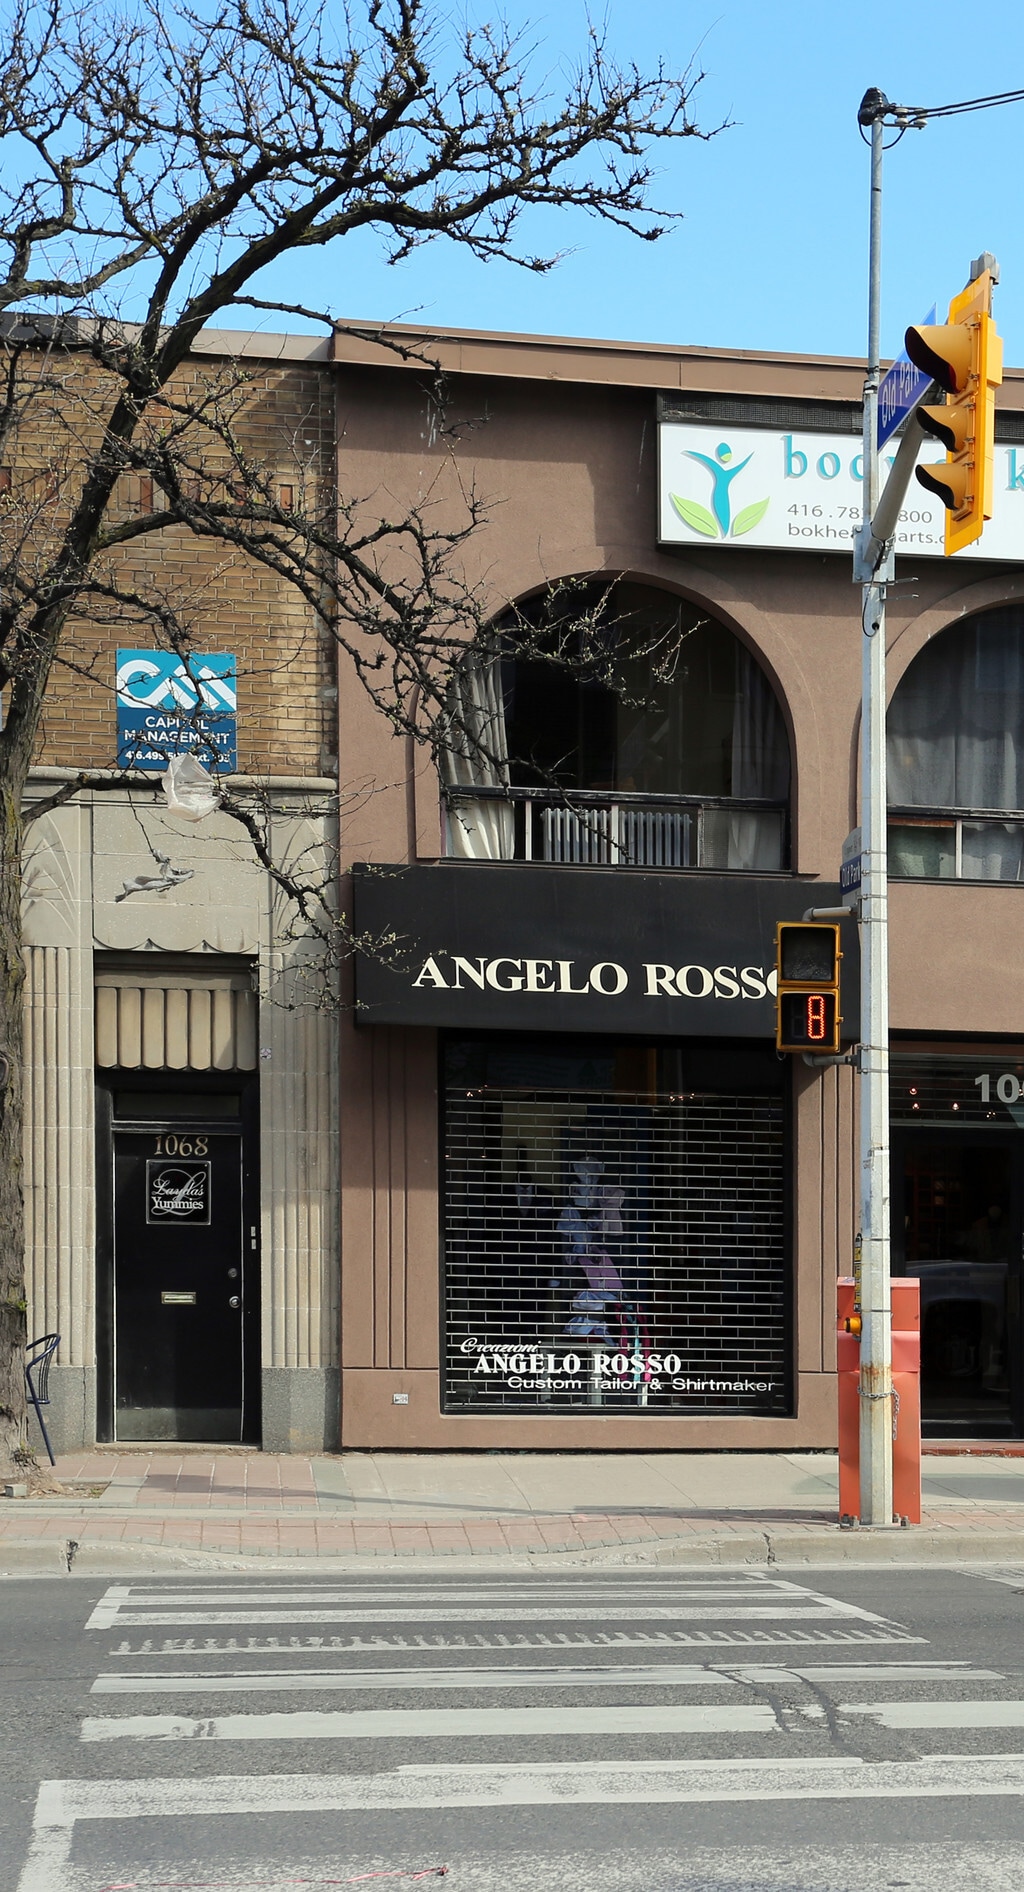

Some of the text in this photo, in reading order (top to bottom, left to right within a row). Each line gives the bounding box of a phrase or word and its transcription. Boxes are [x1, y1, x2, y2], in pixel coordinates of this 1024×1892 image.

[882, 372, 897, 428] Old
[781, 434, 896, 481] bo
[411, 956, 629, 995] ANGELO
[807, 995, 825, 1040] 8
[153, 1135, 209, 1157] 1068
[152, 1195, 204, 1210] Yummies
[460, 1337, 542, 1353] Creazioni
[473, 1353, 682, 1375] ANGELO ROSSO
[507, 1375, 776, 1392] Custom Tailor & Shirtmaker
